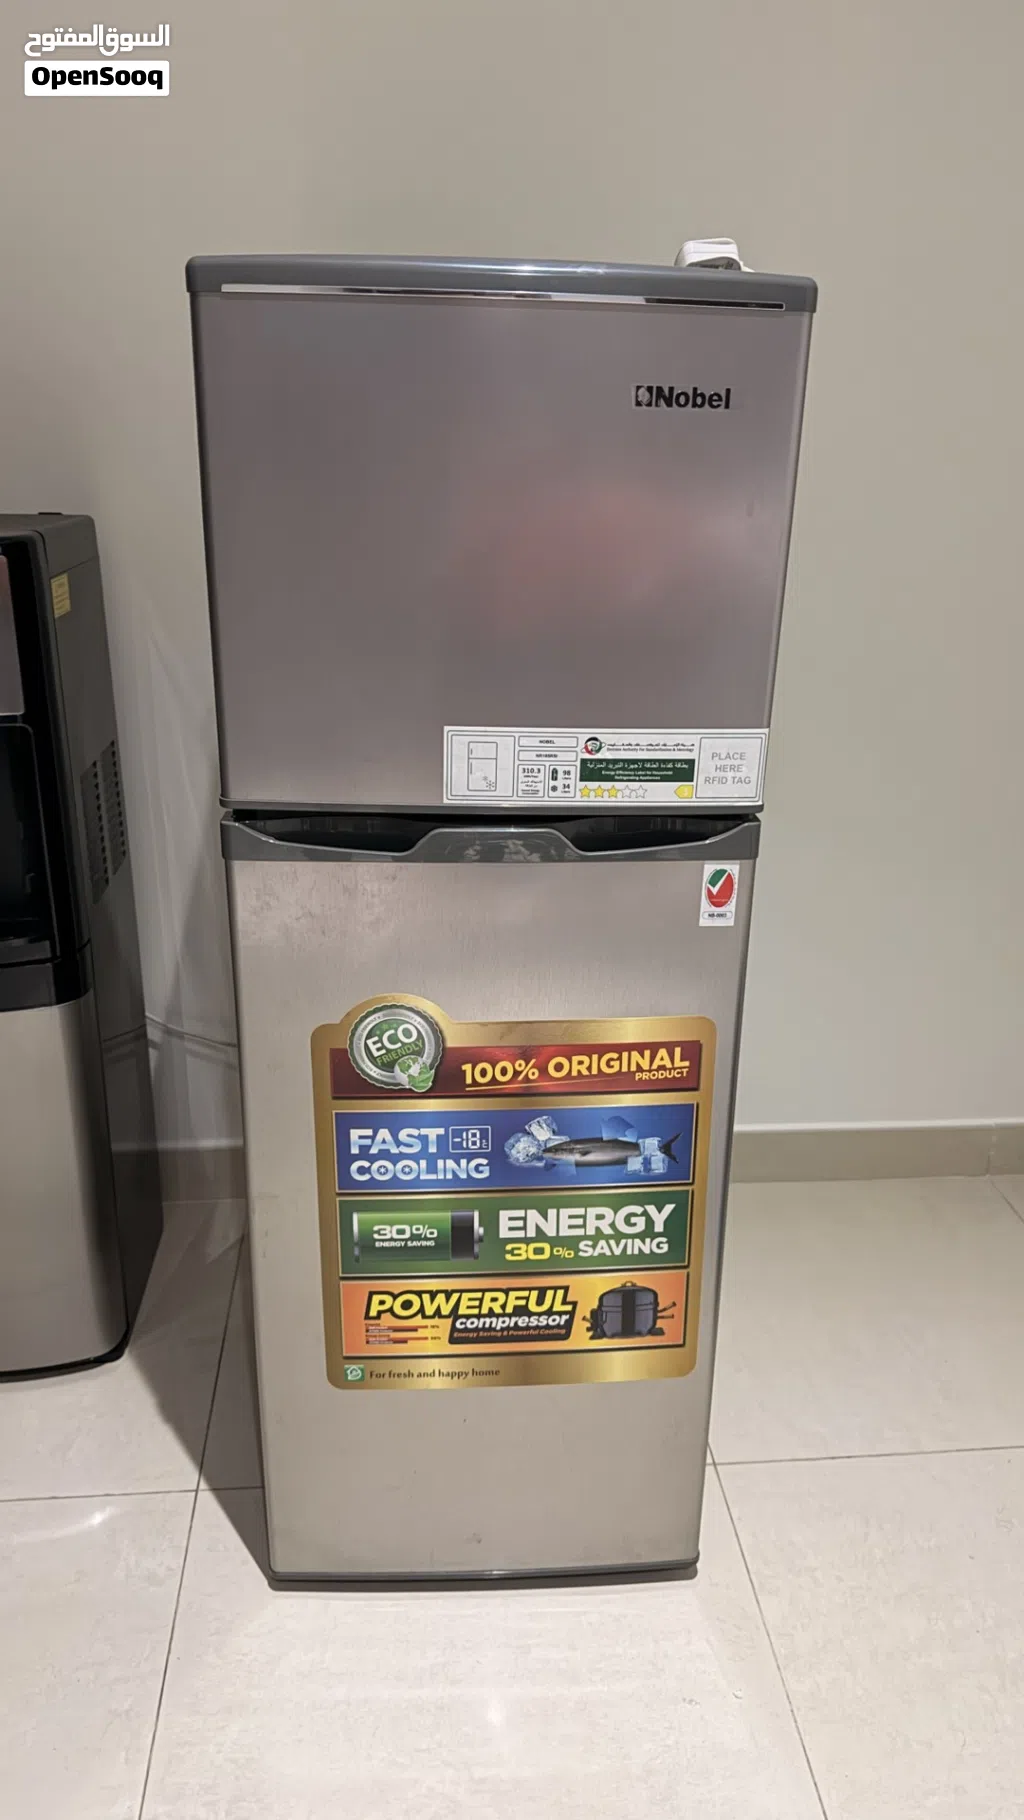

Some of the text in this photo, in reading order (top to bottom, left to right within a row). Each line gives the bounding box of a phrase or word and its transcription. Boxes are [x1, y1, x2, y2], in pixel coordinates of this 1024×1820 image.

[655, 386, 731, 409] Nobel
[711, 752, 747, 761] PLACE
[521, 767, 541, 775] 310.3
[562, 769, 572, 777] 98
[714, 764, 744, 773] HERE
[704, 775, 752, 785] RFID TAG
[366, 1023, 418, 1058] ECO
[376, 1039, 424, 1066] FRIENDLY
[461, 1046, 690, 1085] 100% ORIGINAL
[635, 1068, 690, 1082] PRODUCT
[350, 1127, 445, 1155] FAST
[350, 1157, 490, 1182] COOLING
[499, 1203, 677, 1239] ENERGY
[372, 1224, 438, 1240] 30%
[578, 1237, 669, 1257] SAVING
[369, 1289, 573, 1317] POWERFUL
[455, 1314, 570, 1331] compressor
[369, 1368, 500, 1380] For fresh and happy home
